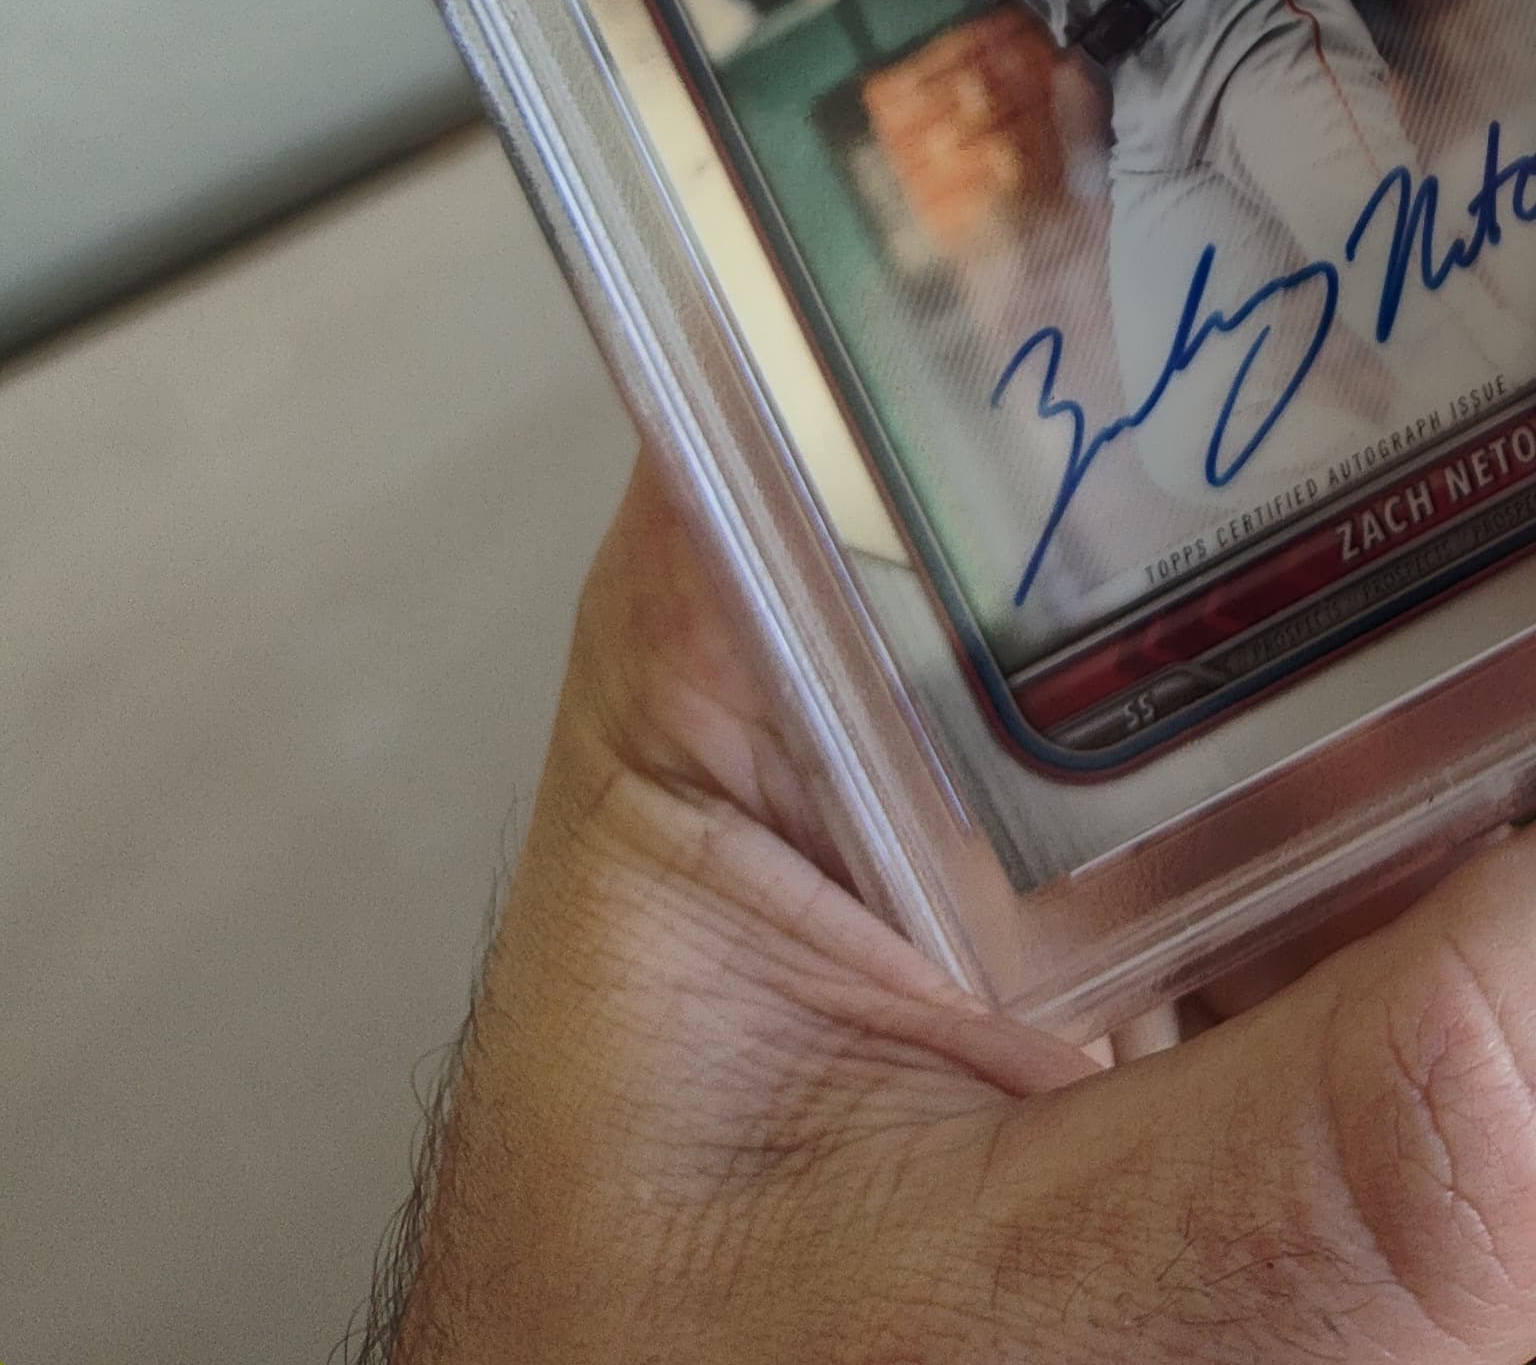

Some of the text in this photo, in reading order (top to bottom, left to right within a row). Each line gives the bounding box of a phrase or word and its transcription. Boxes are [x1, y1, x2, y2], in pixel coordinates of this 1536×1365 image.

[1143, 373, 1507, 584] TOPPS CERTIFIED AUTOGRAPH ISSUE
[1335, 483, 1436, 564] ZACH
[1124, 693, 1157, 728] SS
